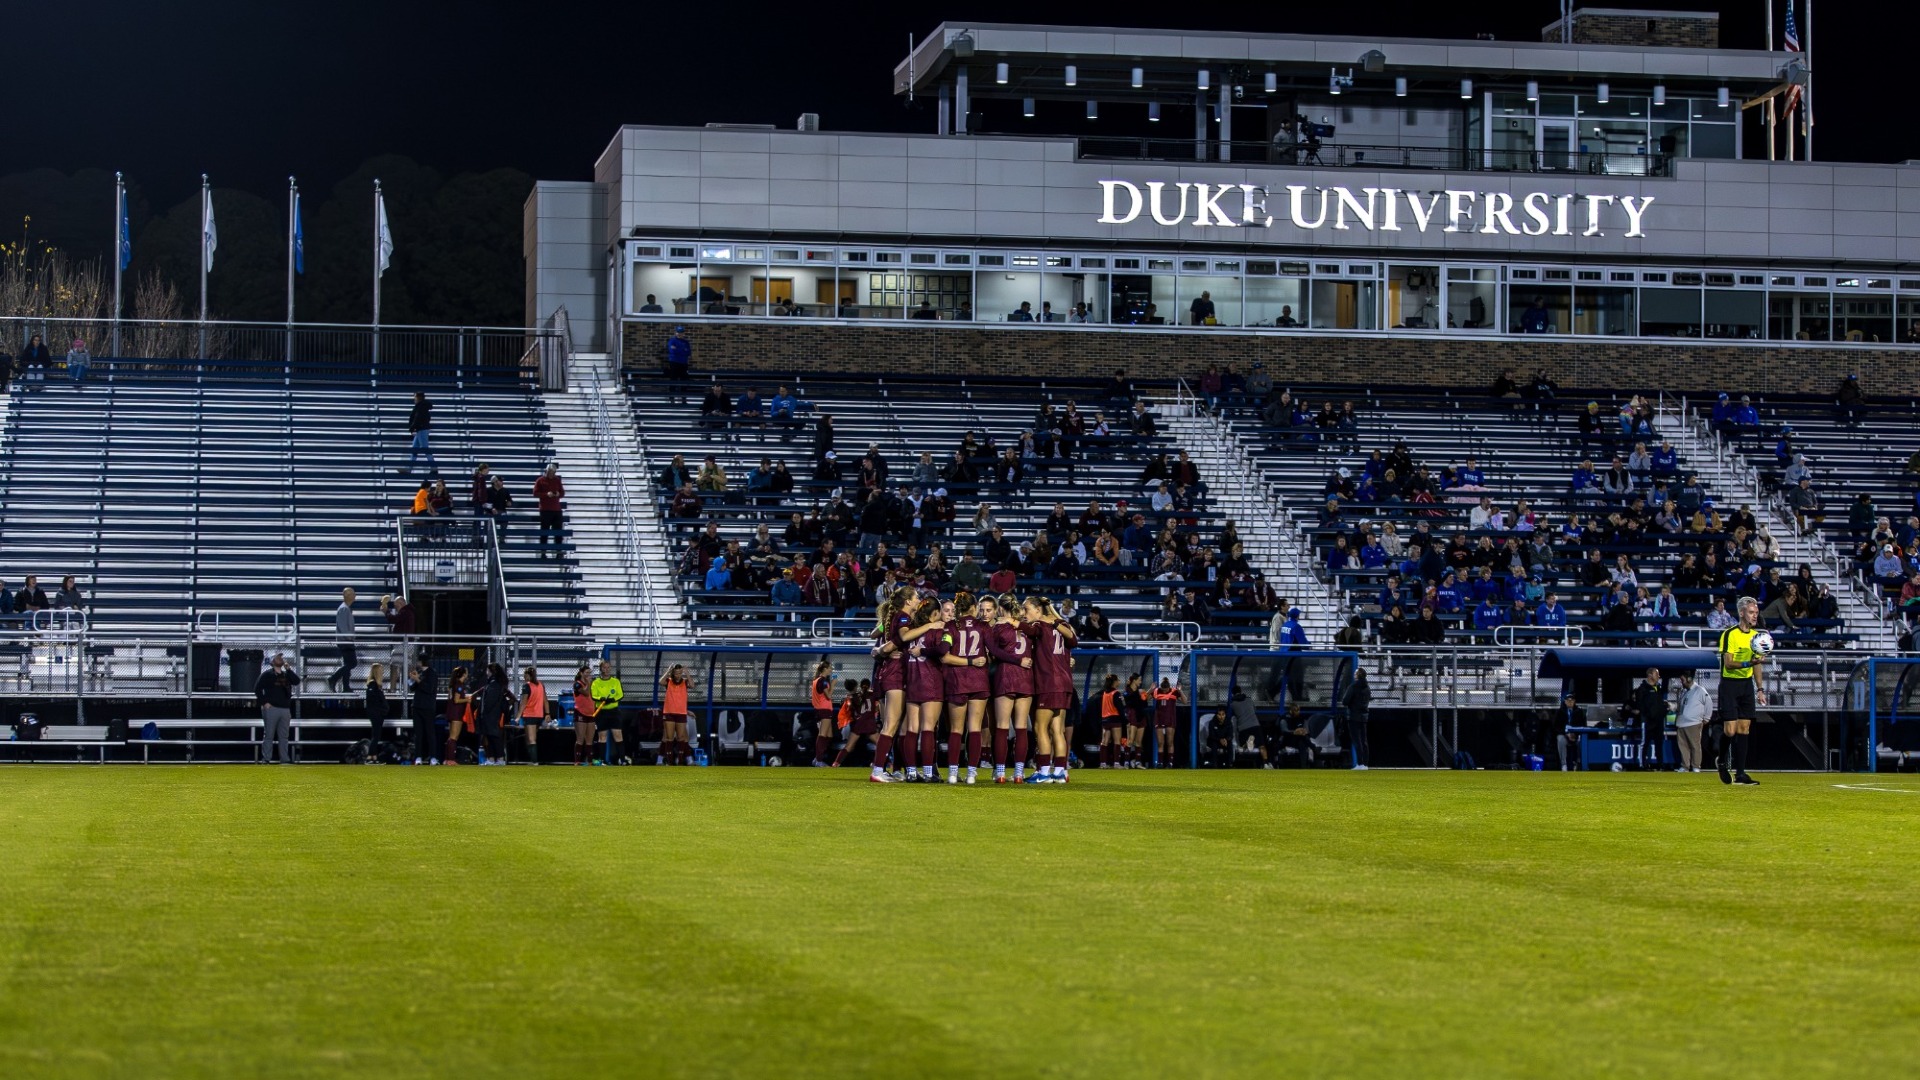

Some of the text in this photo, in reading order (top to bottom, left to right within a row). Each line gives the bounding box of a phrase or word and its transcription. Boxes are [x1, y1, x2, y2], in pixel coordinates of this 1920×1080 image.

[1097, 180, 1655, 238] DUKE UNIVERSITY
[959, 630, 980, 657] 12
[1015, 629, 1028, 655] 5
